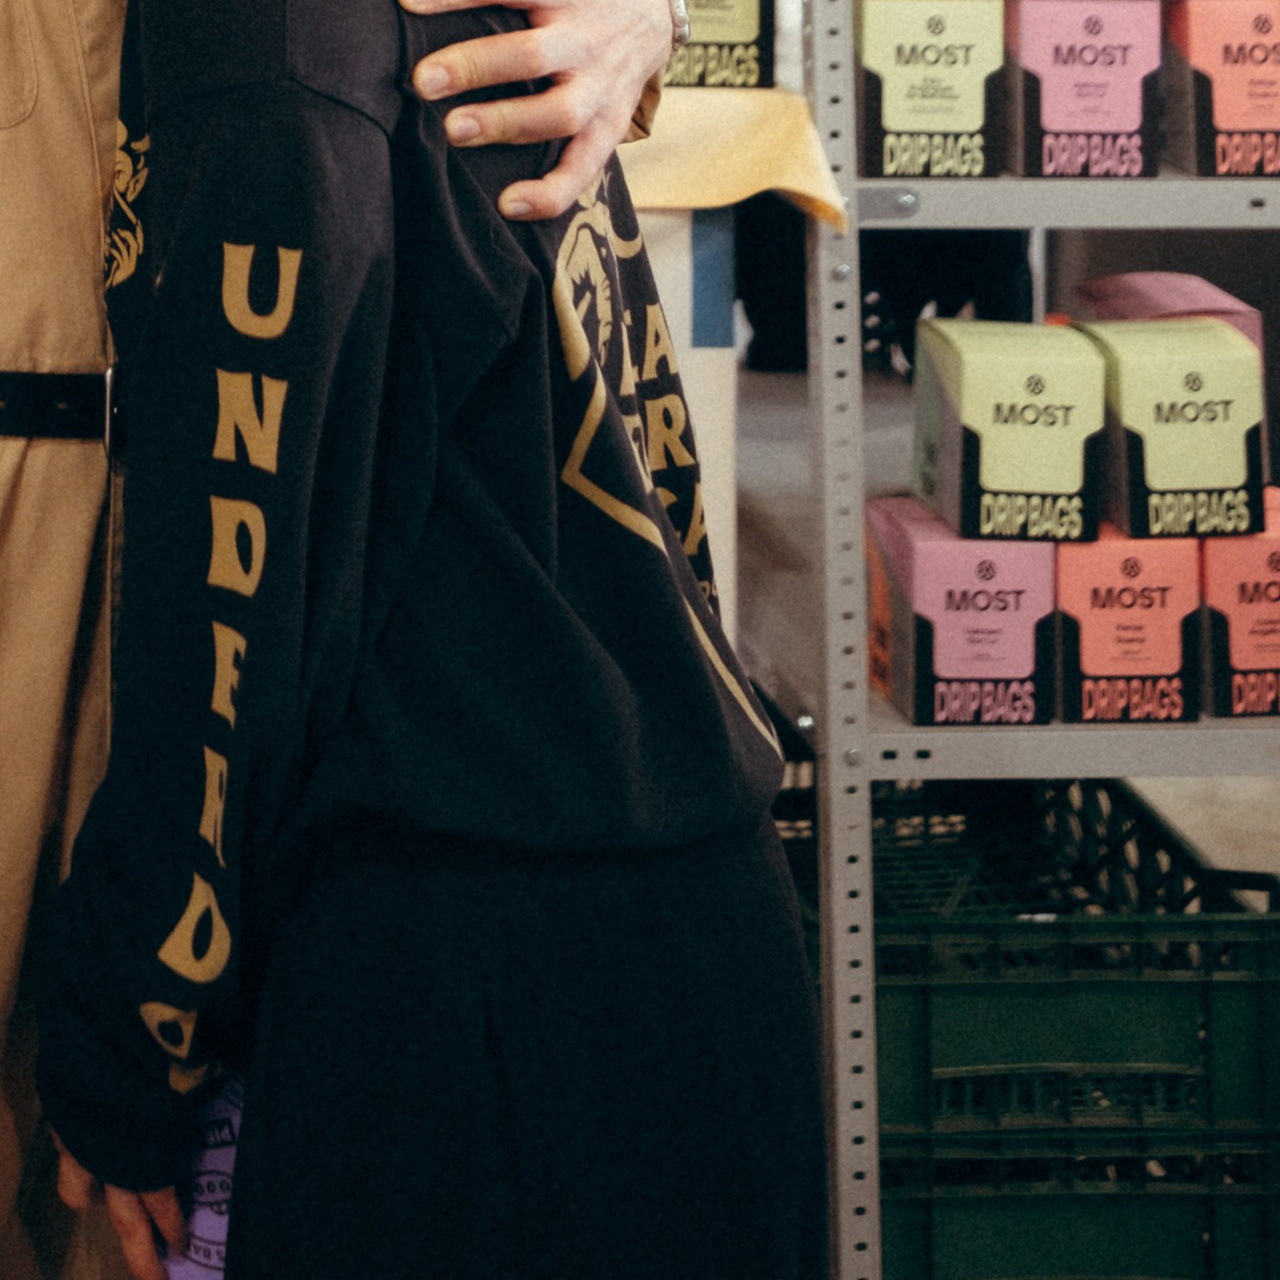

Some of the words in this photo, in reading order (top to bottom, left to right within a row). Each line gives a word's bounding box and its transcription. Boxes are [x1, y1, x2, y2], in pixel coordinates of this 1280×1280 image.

[663, 44, 704, 87] RIP
[895, 44, 973, 66] MOST
[1053, 45, 1131, 66] MOST
[994, 403, 1074, 426] MOST
[1155, 400, 1234, 424] MOST
[946, 590, 1025, 612] MOST
[1091, 587, 1171, 609] MOST
